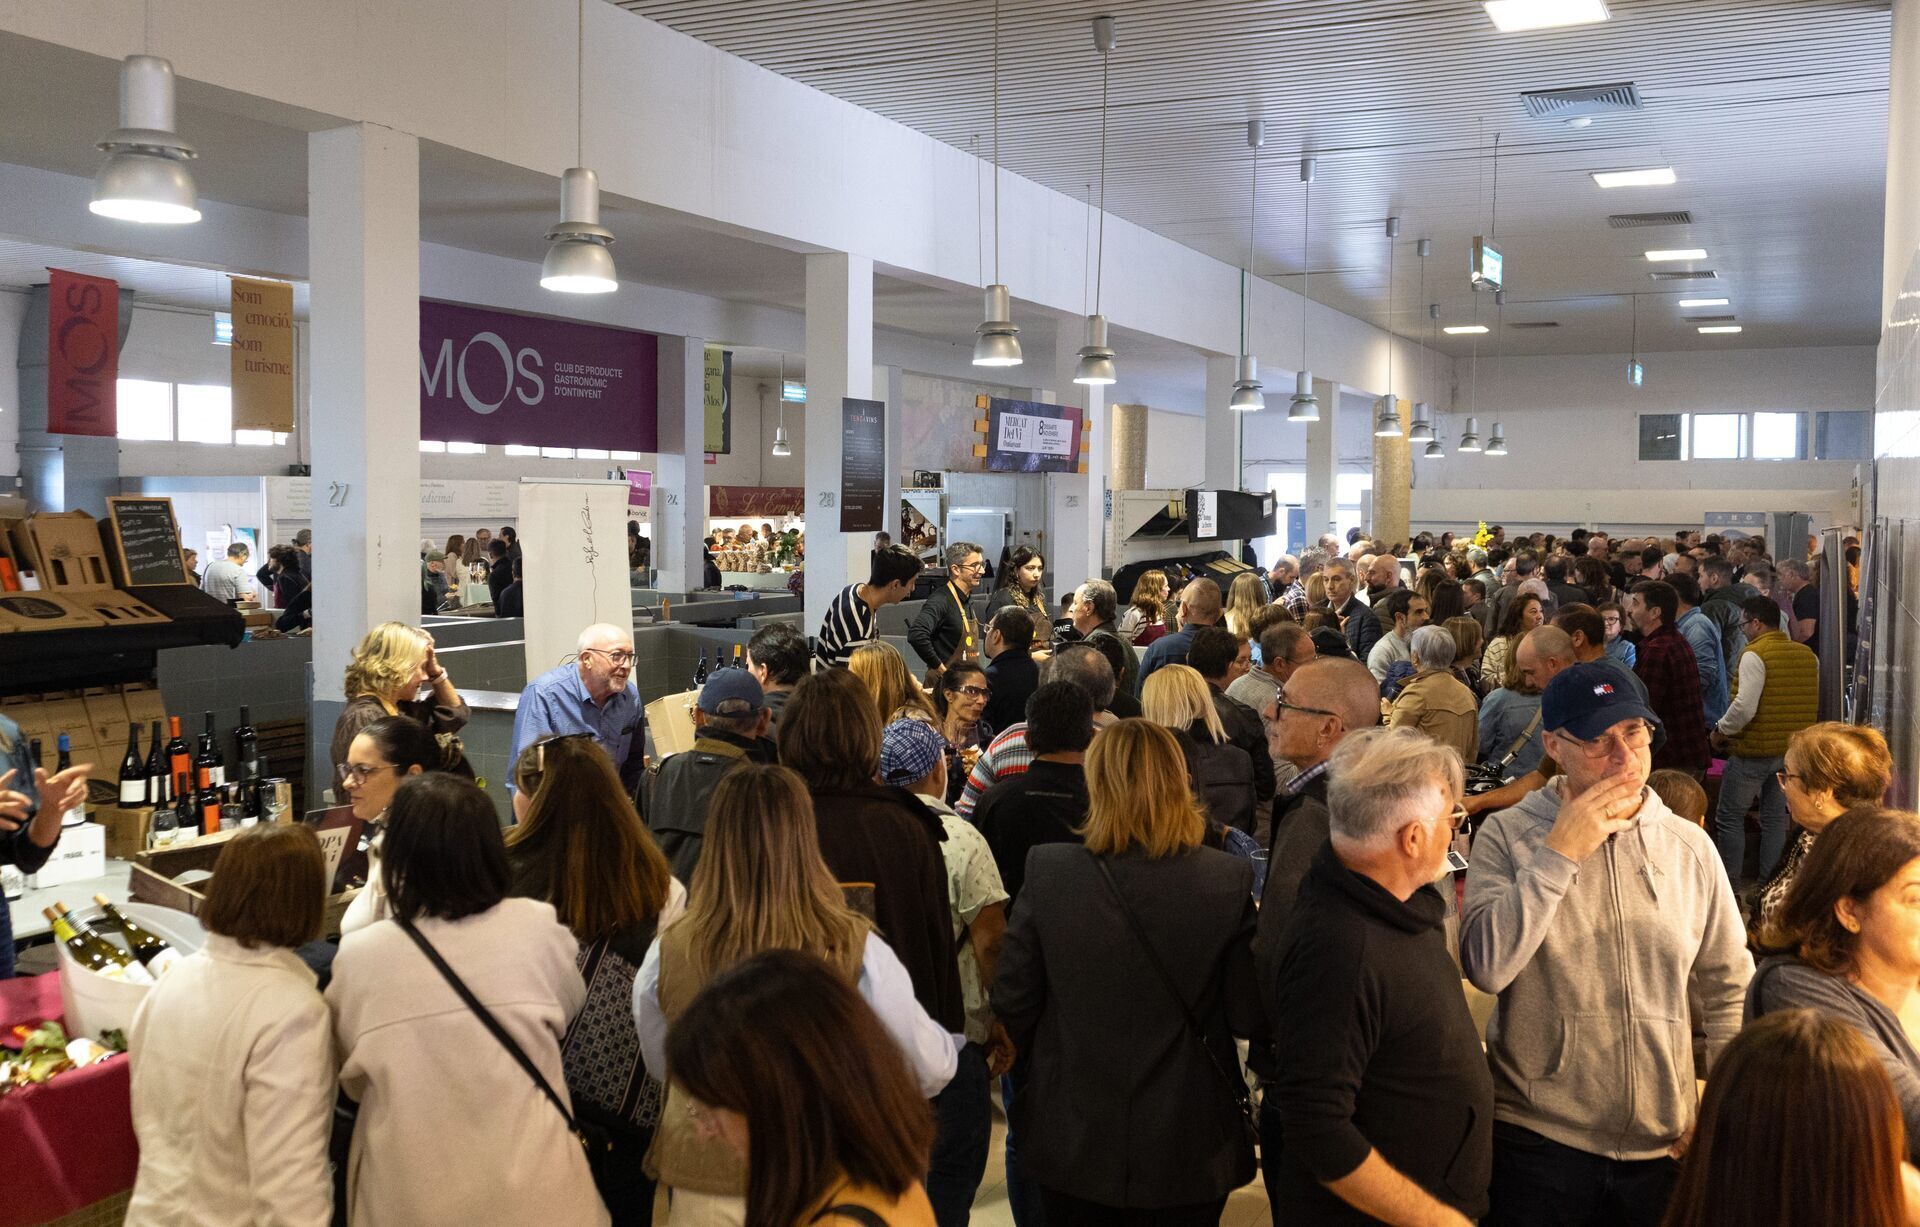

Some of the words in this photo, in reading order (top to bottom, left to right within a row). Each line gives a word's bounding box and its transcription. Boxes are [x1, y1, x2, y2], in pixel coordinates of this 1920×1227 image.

[233, 287, 262, 304] Som
[245, 312, 291, 329] emoció.
[232, 335, 262, 352] Som
[58, 282, 109, 424] MOS
[245, 358, 290, 375] turisme.
[554, 361, 574, 373] CLUB
[574, 364, 585, 374] DE
[585, 365, 623, 378] PRODUCTE
[554, 374, 608, 388] GASTRONÒMIC
[554, 386, 602, 399] D'ONTINYENT
[329, 480, 350, 507] 27
[421, 490, 456, 504] edicinal
[818, 491, 835, 509] 28
